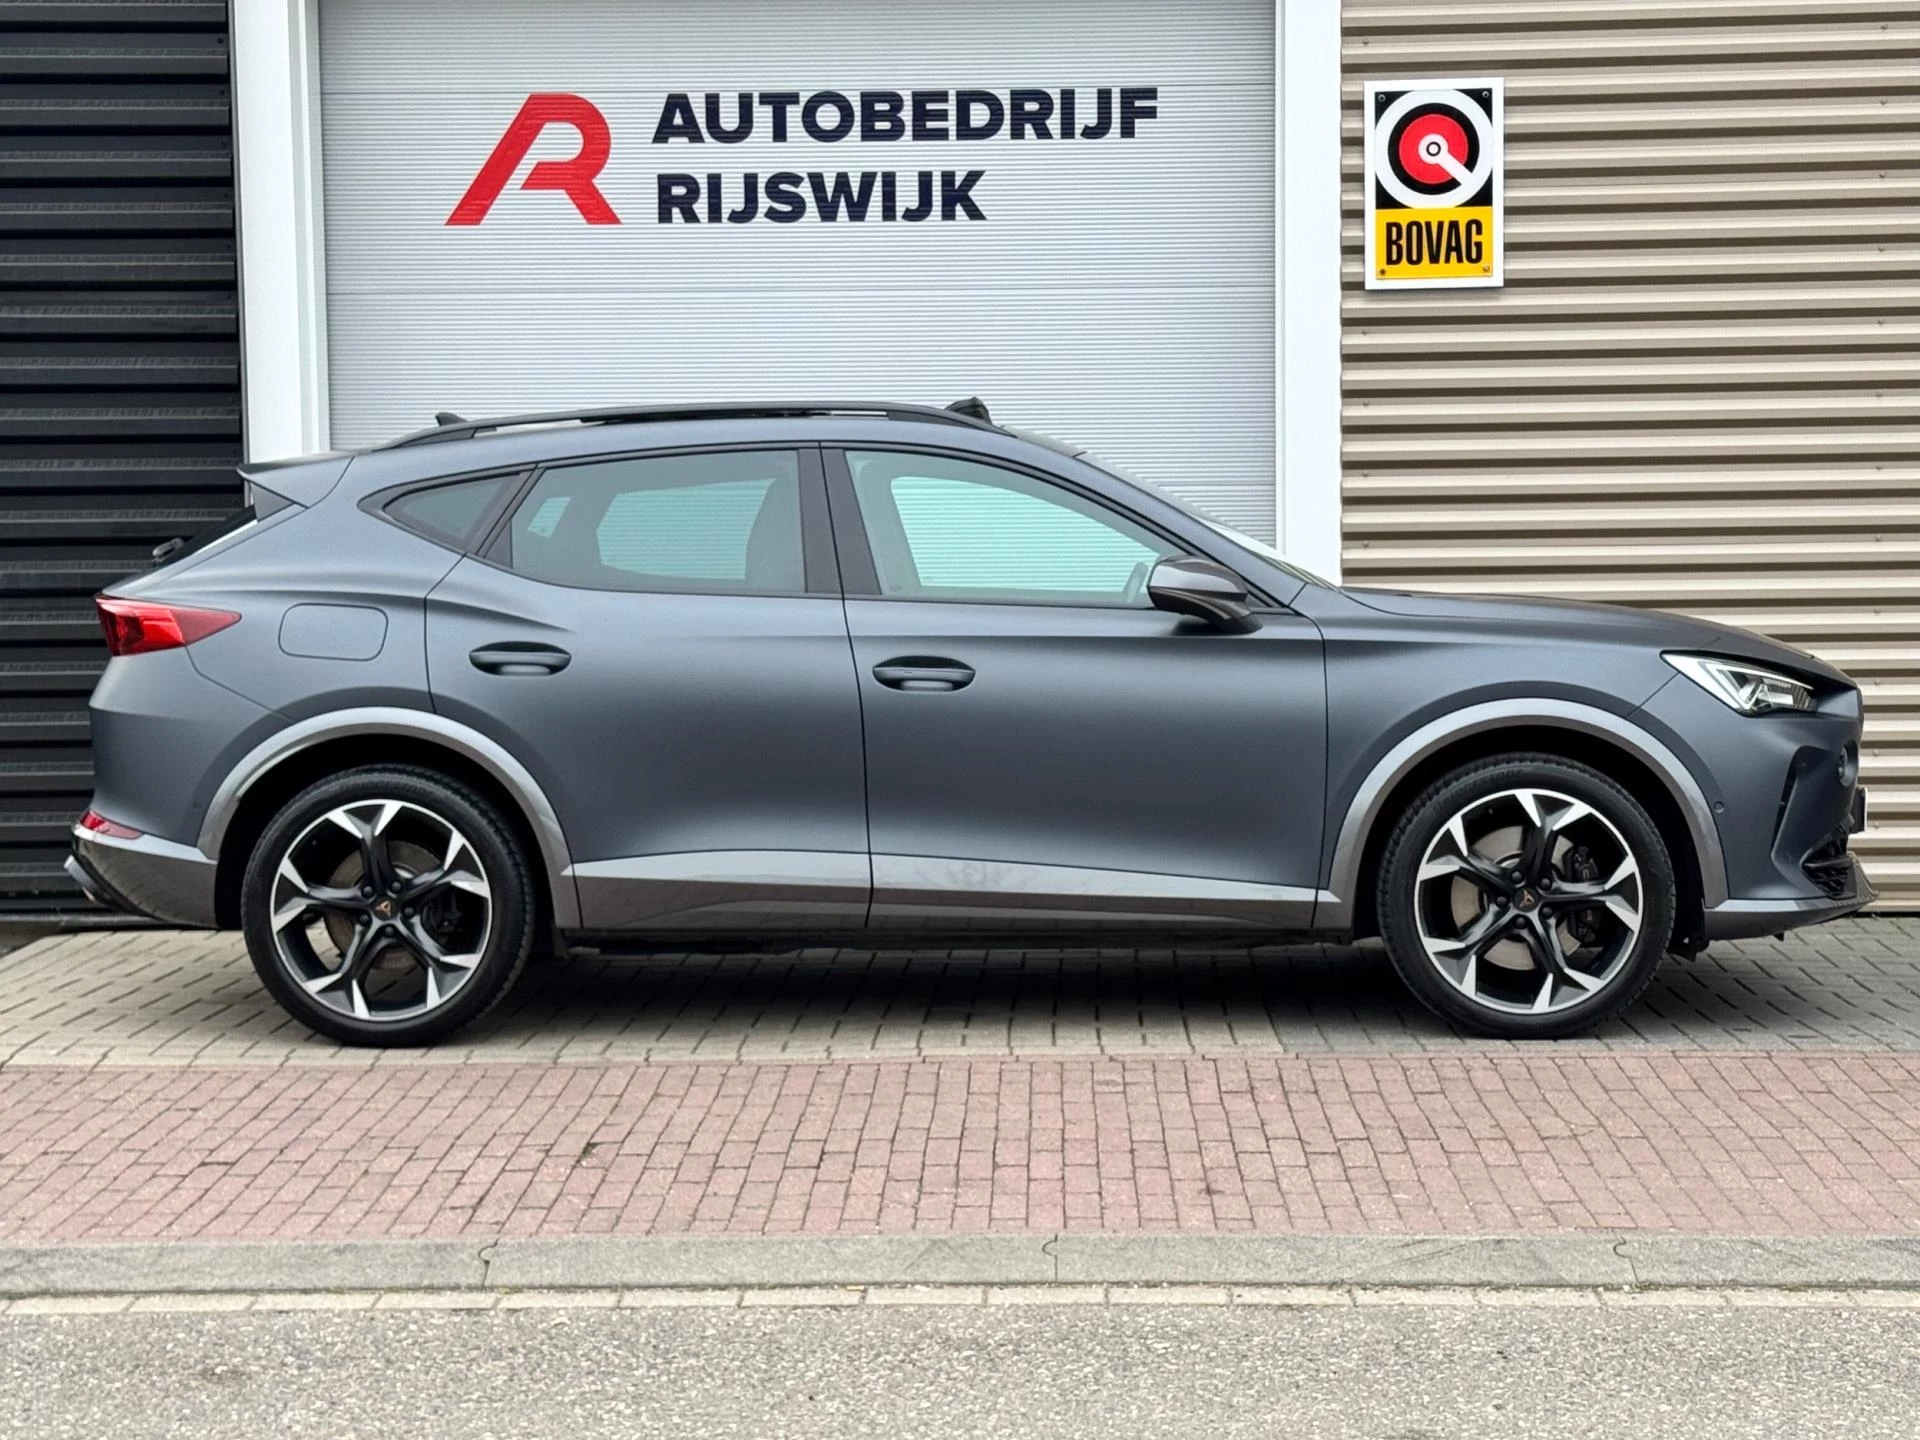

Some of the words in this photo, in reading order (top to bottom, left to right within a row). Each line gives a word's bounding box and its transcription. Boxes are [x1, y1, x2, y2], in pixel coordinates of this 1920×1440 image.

[653, 88, 1158, 144] AUTOBEDRIJF
[658, 170, 987, 225] RIJSWIJK
[1385, 218, 1484, 267] BOVAG
